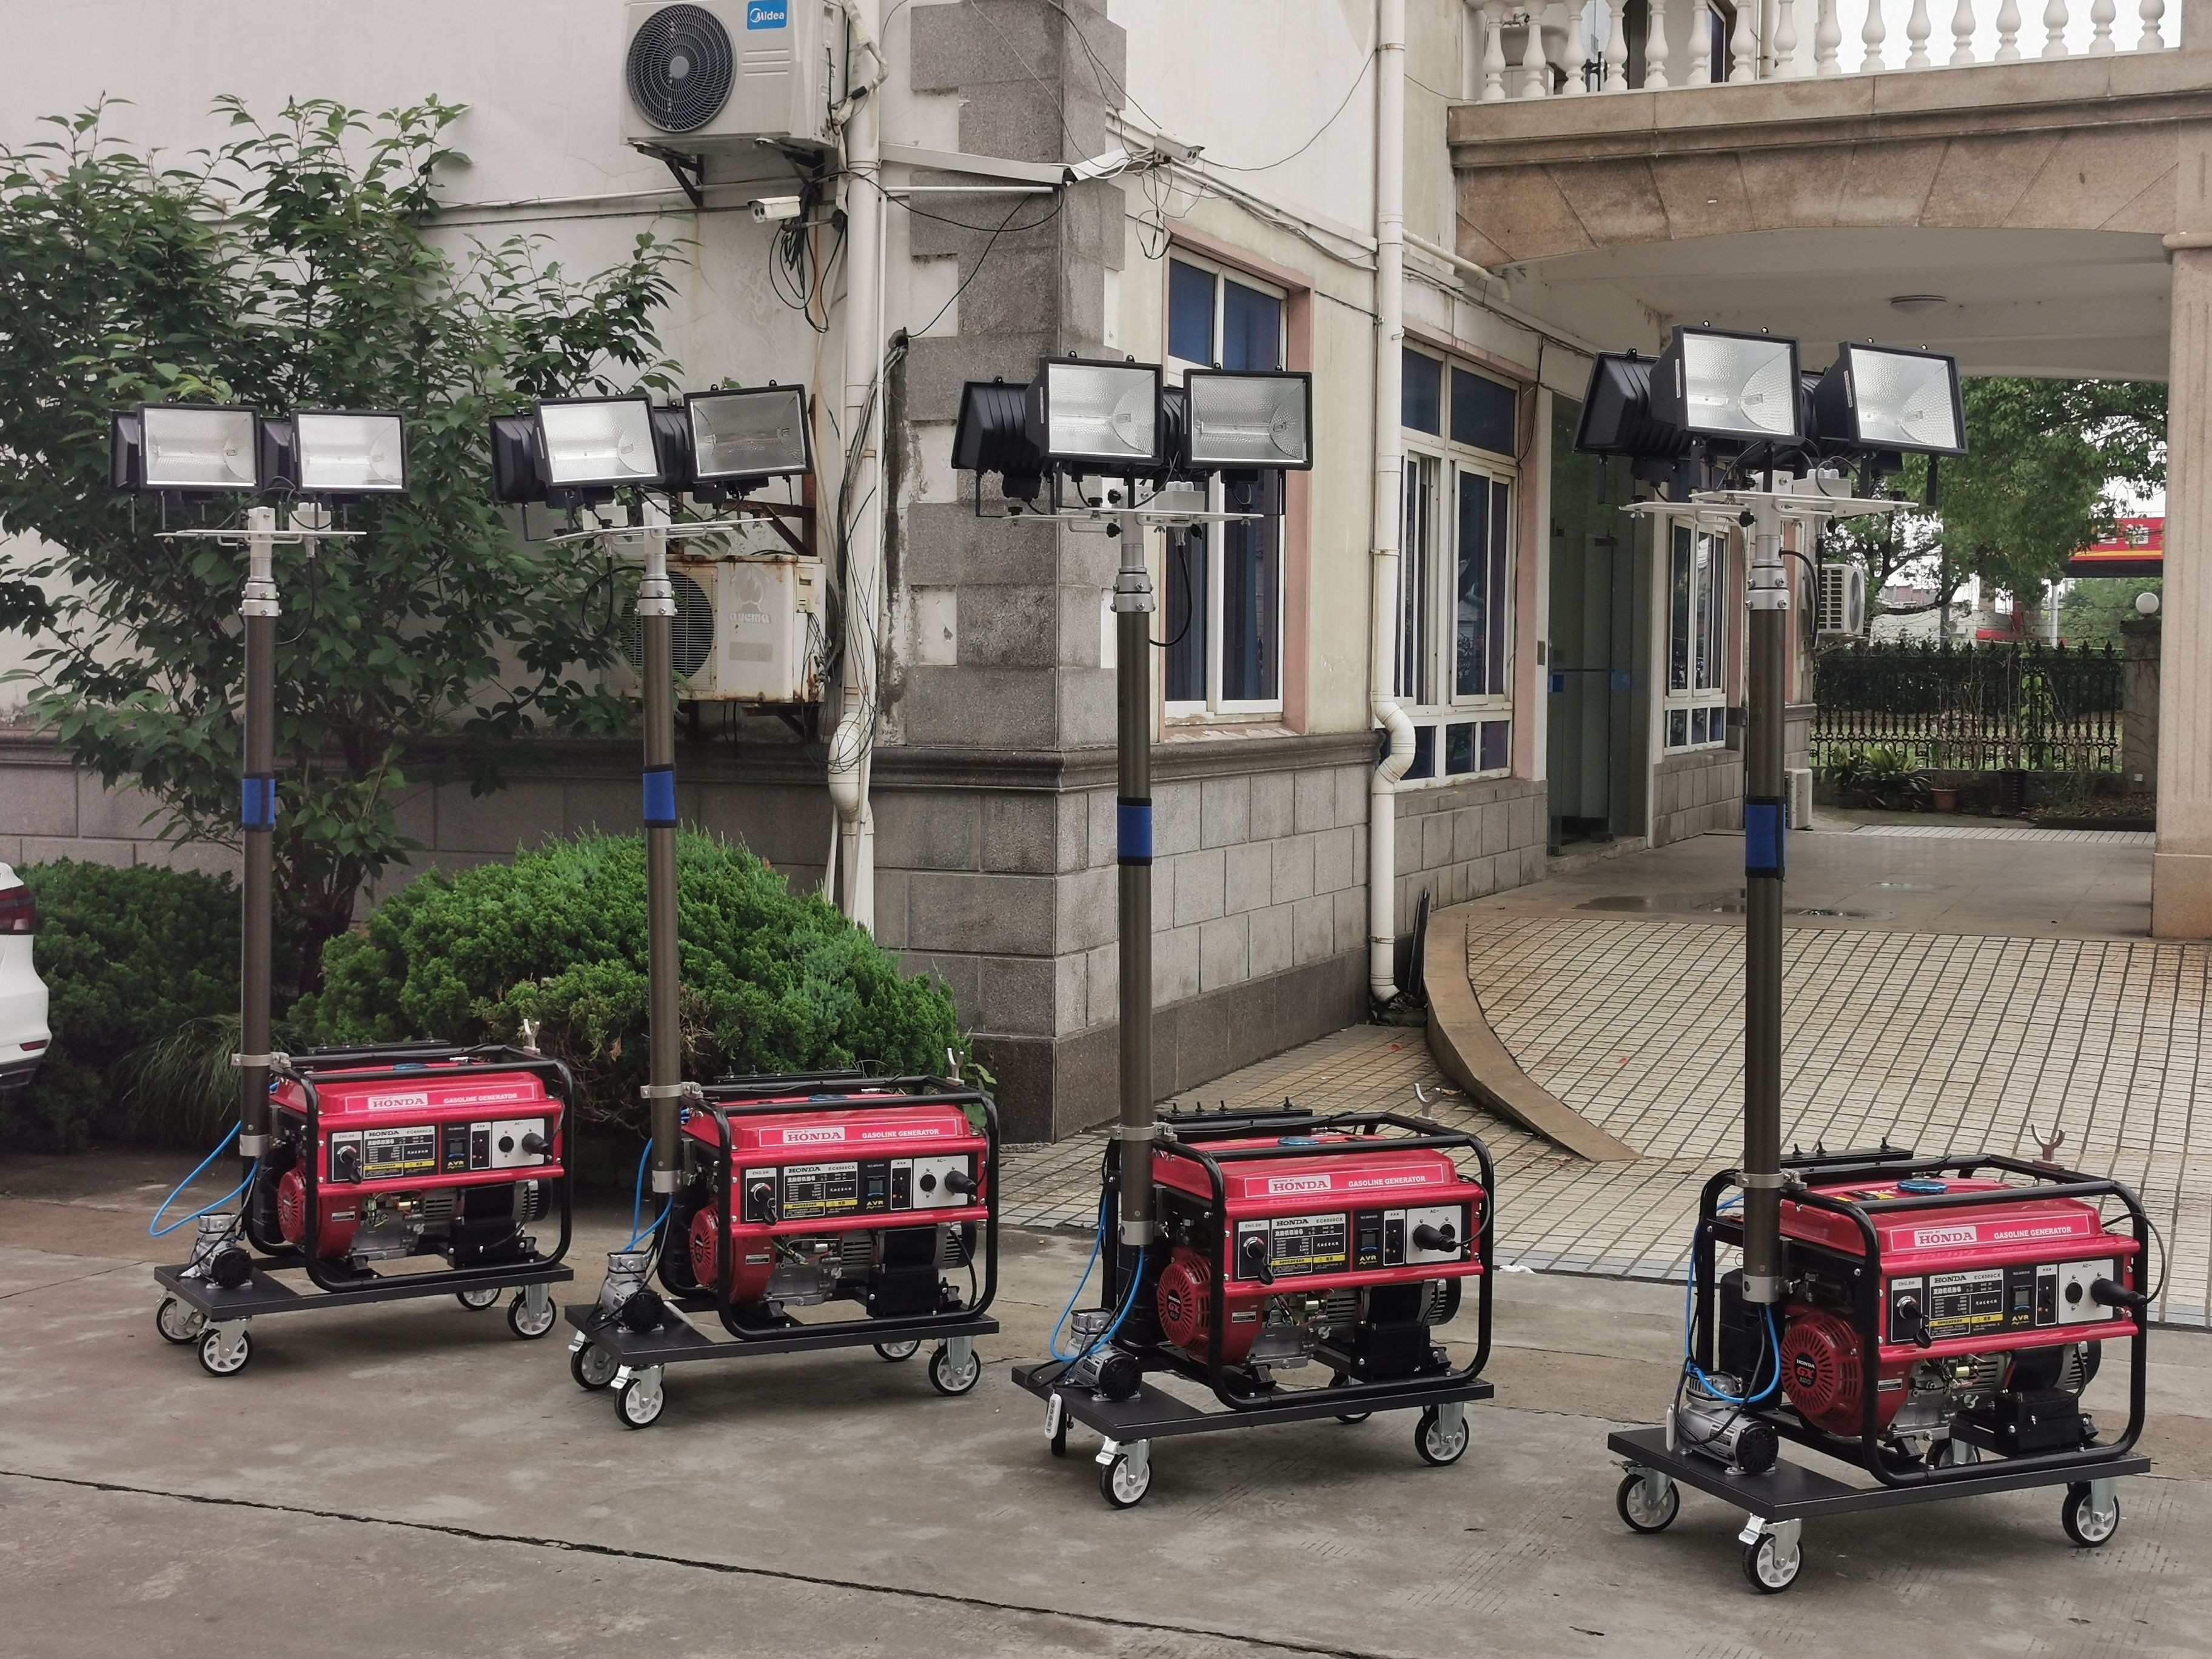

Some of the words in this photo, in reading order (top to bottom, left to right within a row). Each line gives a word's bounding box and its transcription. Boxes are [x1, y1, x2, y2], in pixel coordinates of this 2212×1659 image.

[752, 9, 785, 22] Midea
[373, 1098, 426, 1108] HONDA
[788, 1132, 842, 1142] HONDA
[898, 1128, 939, 1137] GENERATOR
[1273, 1181, 1329, 1191] HONDA
[1348, 1179, 1384, 1187] GASOLINE
[1385, 1176, 1426, 1185] GENERATOR
[1994, 1230, 2029, 1239] GASOLINE
[2031, 1226, 2072, 1236] GENERATOR
[1919, 1232, 1974, 1244] HONDA
[1934, 1275, 1967, 1284] HONDA
[1796, 1359, 1815, 1369] HONDA
[1797, 1366, 1814, 1379] GX
